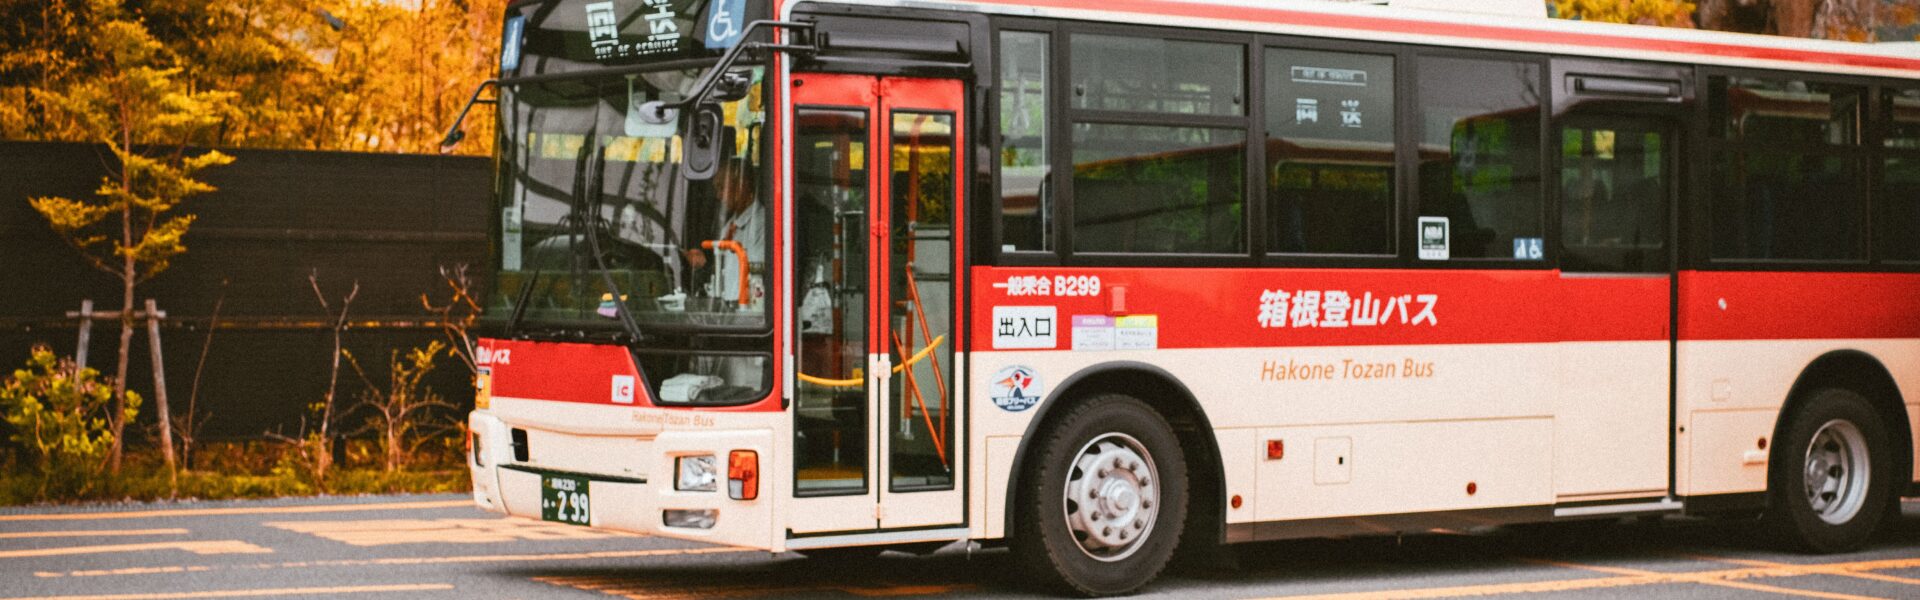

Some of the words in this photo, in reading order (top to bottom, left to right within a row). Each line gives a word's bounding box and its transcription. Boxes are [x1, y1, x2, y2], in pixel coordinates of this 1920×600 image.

[992, 276, 1052, 296] 一般乗合
[1054, 275, 1101, 297] B299
[1257, 288, 1438, 328] 箱根登山バス
[998, 317, 1051, 337] 出入口
[1261, 358, 1335, 382] Hakone
[1342, 359, 1396, 380] Tozan
[1403, 357, 1434, 379] Bus
[557, 490, 589, 524] 299
